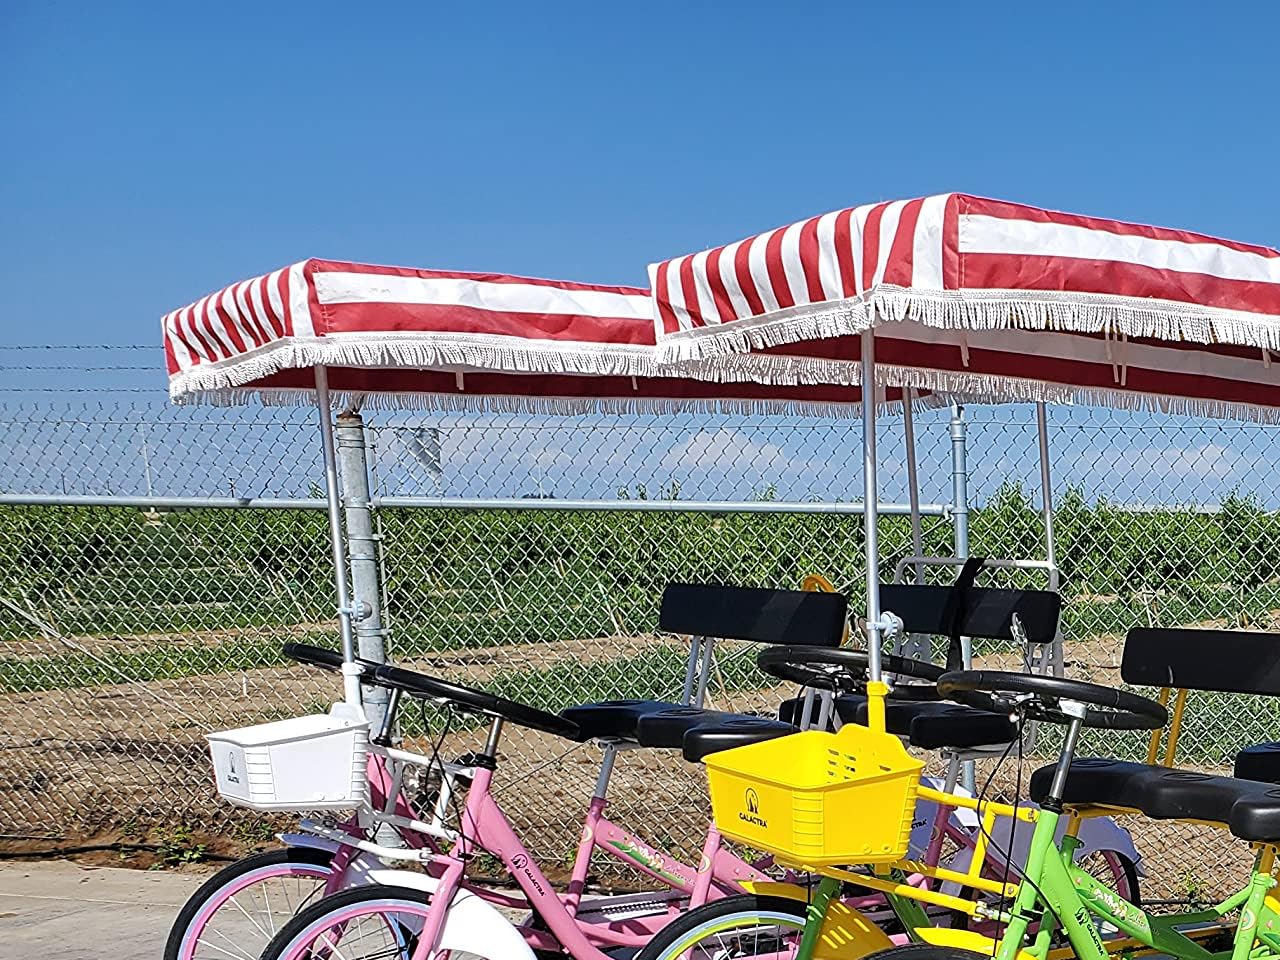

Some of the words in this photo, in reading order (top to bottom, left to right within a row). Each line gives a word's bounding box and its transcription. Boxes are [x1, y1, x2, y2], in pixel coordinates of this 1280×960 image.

[739, 812, 767, 828] GALACTRA
[911, 820, 926, 829] CTRA
[524, 868, 545, 896] GALACTRA
[1086, 923, 1104, 956] GALACTRA
